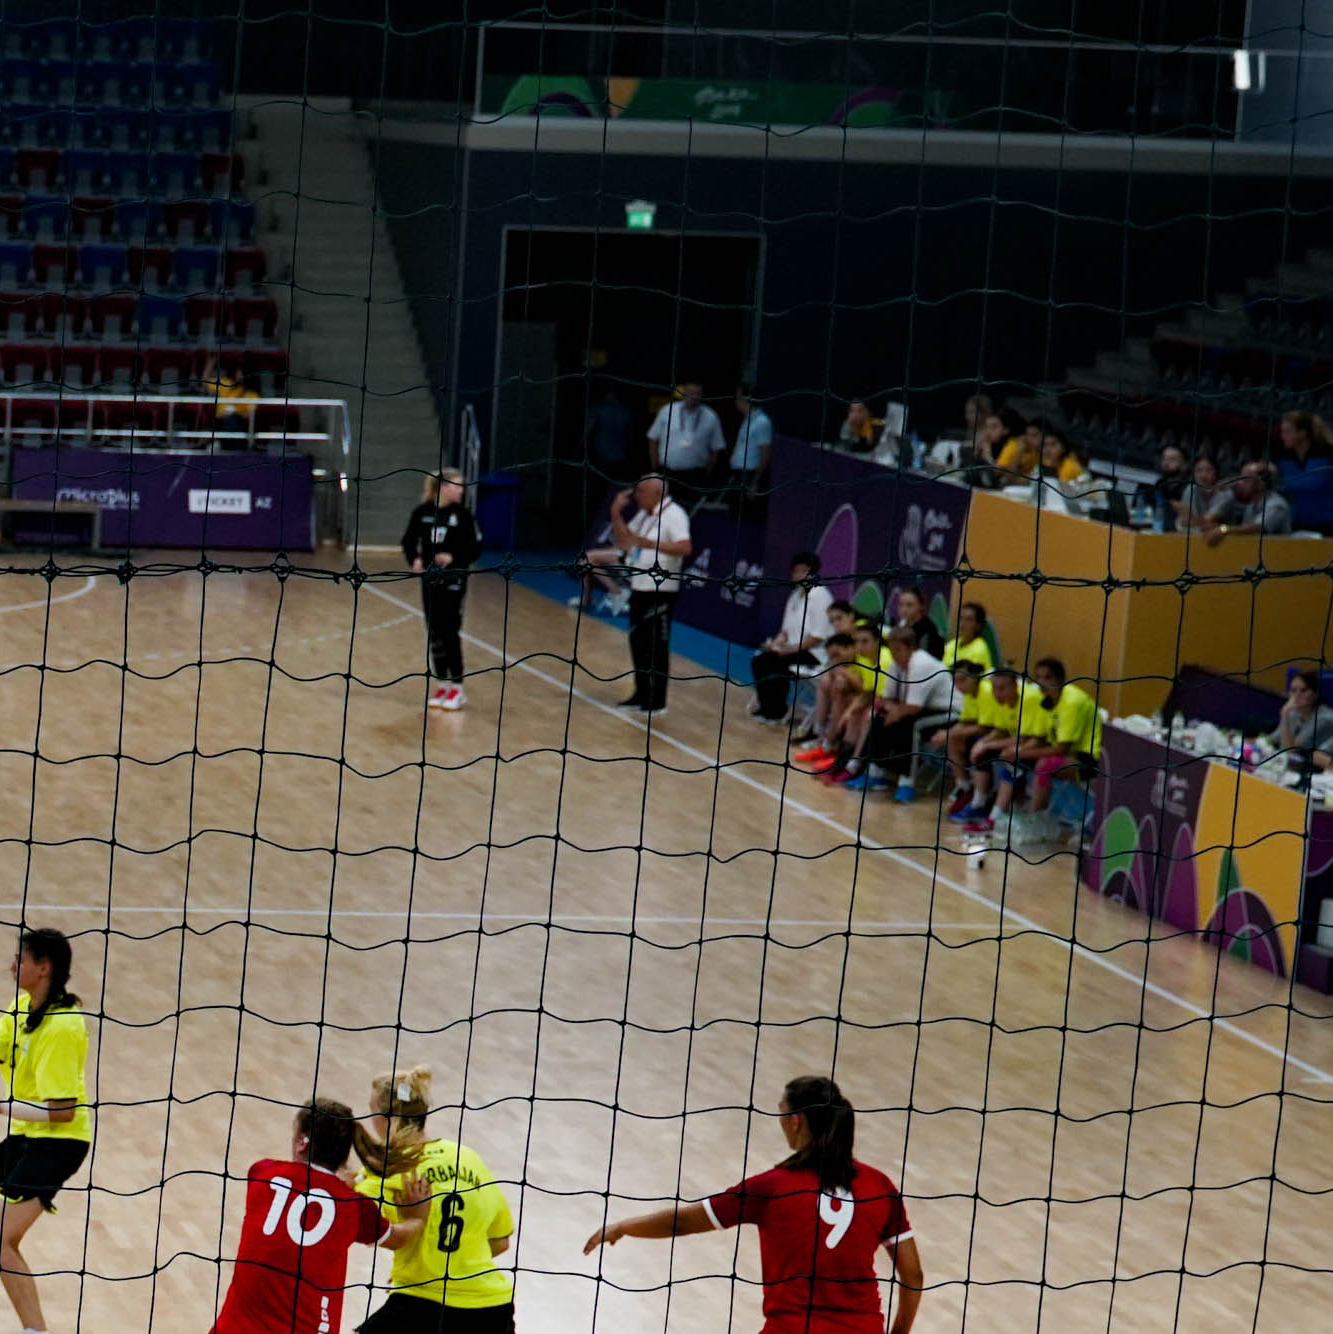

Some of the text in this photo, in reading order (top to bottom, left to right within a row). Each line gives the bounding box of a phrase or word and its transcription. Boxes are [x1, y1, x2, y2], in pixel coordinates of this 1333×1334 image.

[262, 1176, 337, 1247] 10
[437, 1193, 465, 1253] 6
[817, 1185, 855, 1250] 9
